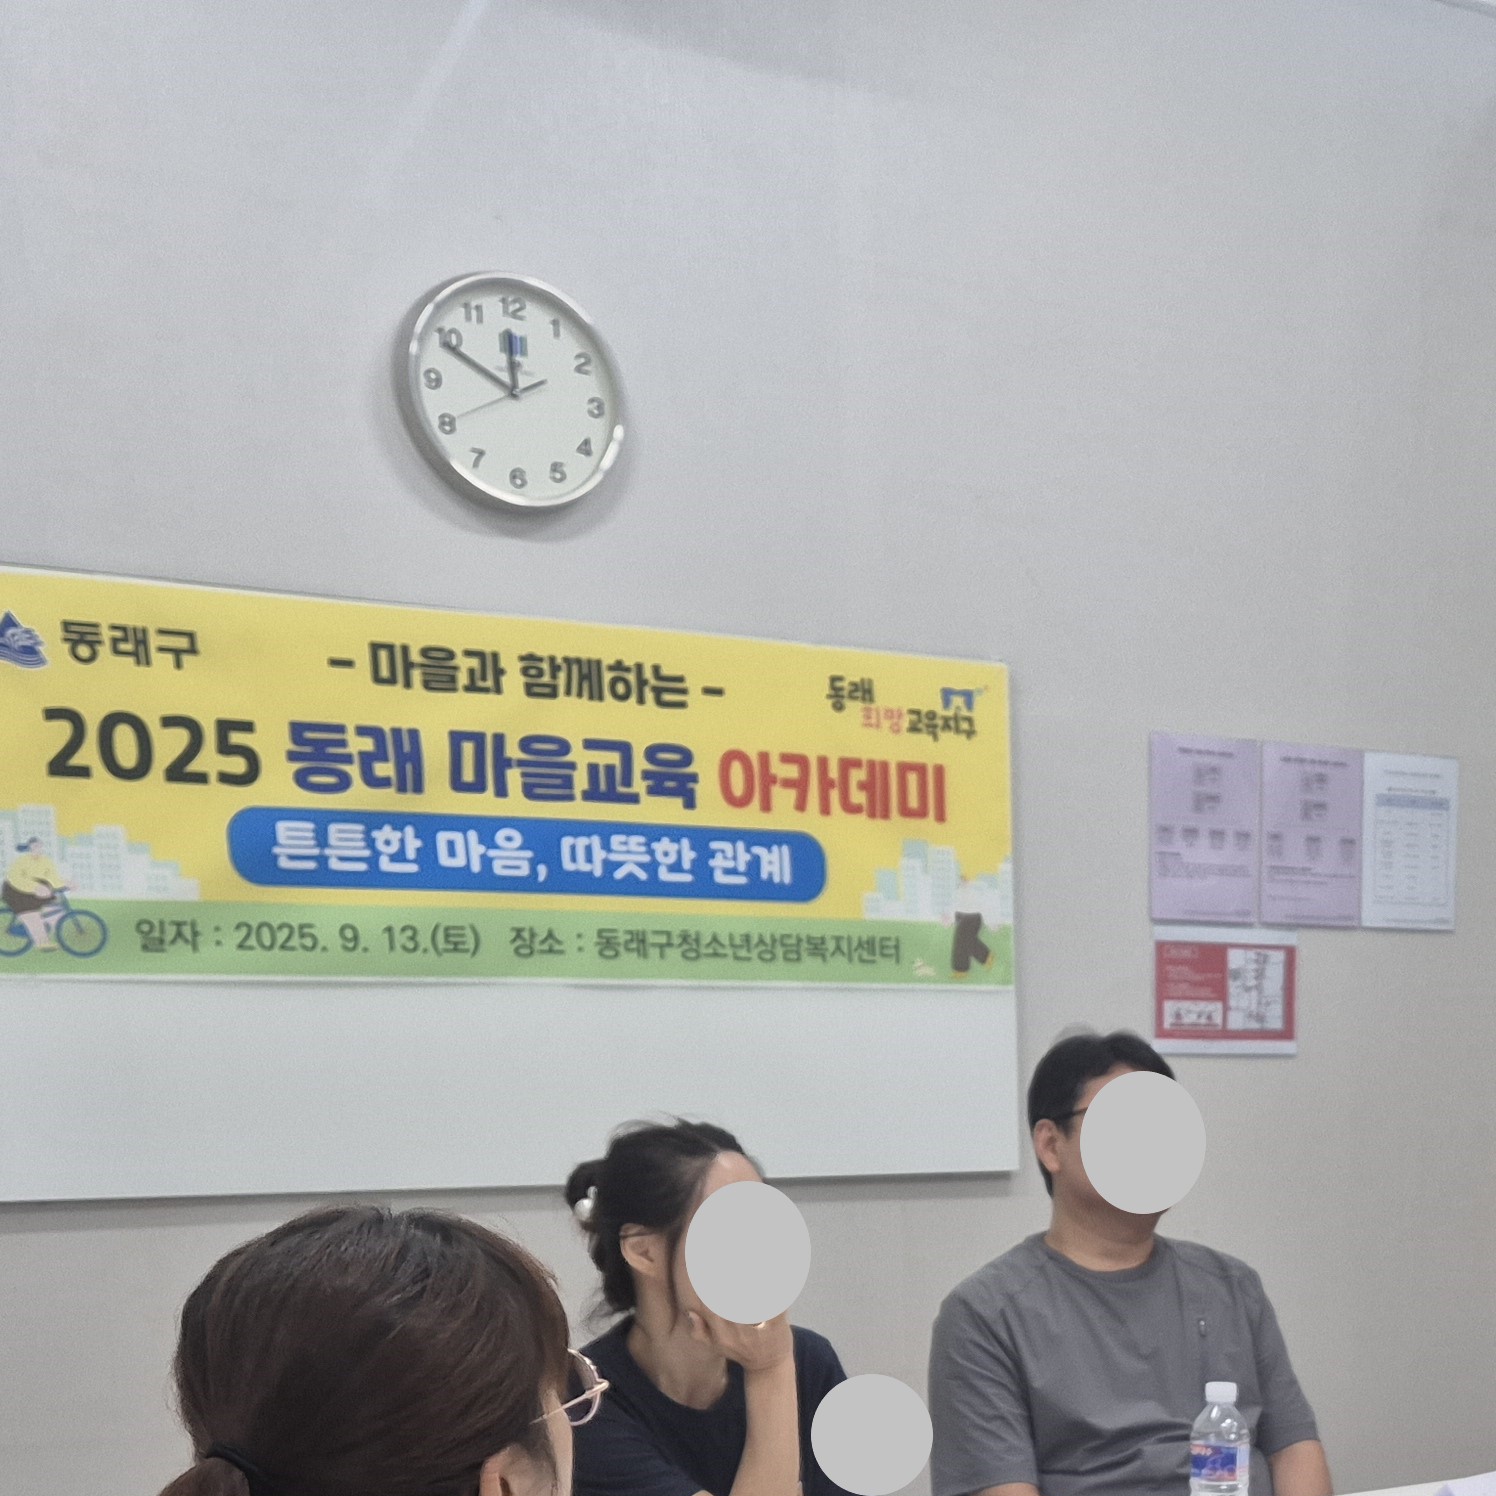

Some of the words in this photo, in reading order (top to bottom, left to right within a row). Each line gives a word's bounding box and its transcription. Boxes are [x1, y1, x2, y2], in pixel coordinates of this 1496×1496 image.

[463, 302, 484, 324] 11
[499, 297, 527, 321] 12
[435, 327, 463, 350] 10
[551, 318, 561, 339] 1
[574, 352, 592, 376] 2
[423, 367, 443, 390] 9
[586, 396, 605, 419] 3
[438, 412, 457, 435] 8
[470, 447, 486, 469] 7
[576, 437, 593, 457] 4
[509, 467, 528, 489] 6
[550, 461, 567, 483] 5
[61, 619, 200, 669] 동래구
[369, 641, 507, 694] 마을과
[518, 652, 689, 709] 함께하는
[826, 674, 875, 713] 동래
[42, 706, 261, 787] 2025
[285, 720, 425, 794] 동래
[448, 729, 699, 811] 마을교육
[718, 748, 947, 823] 아카데미
[272, 819, 423, 873] 튼튼한
[436, 829, 548, 882] 마음,
[560, 833, 697, 883] 따뜻한
[708, 840, 793, 885] 관계
[134, 918, 200, 952] 일자
[509, 926, 565, 958] 장소
[594, 927, 901, 964] 동래구청소년상담복지센터
